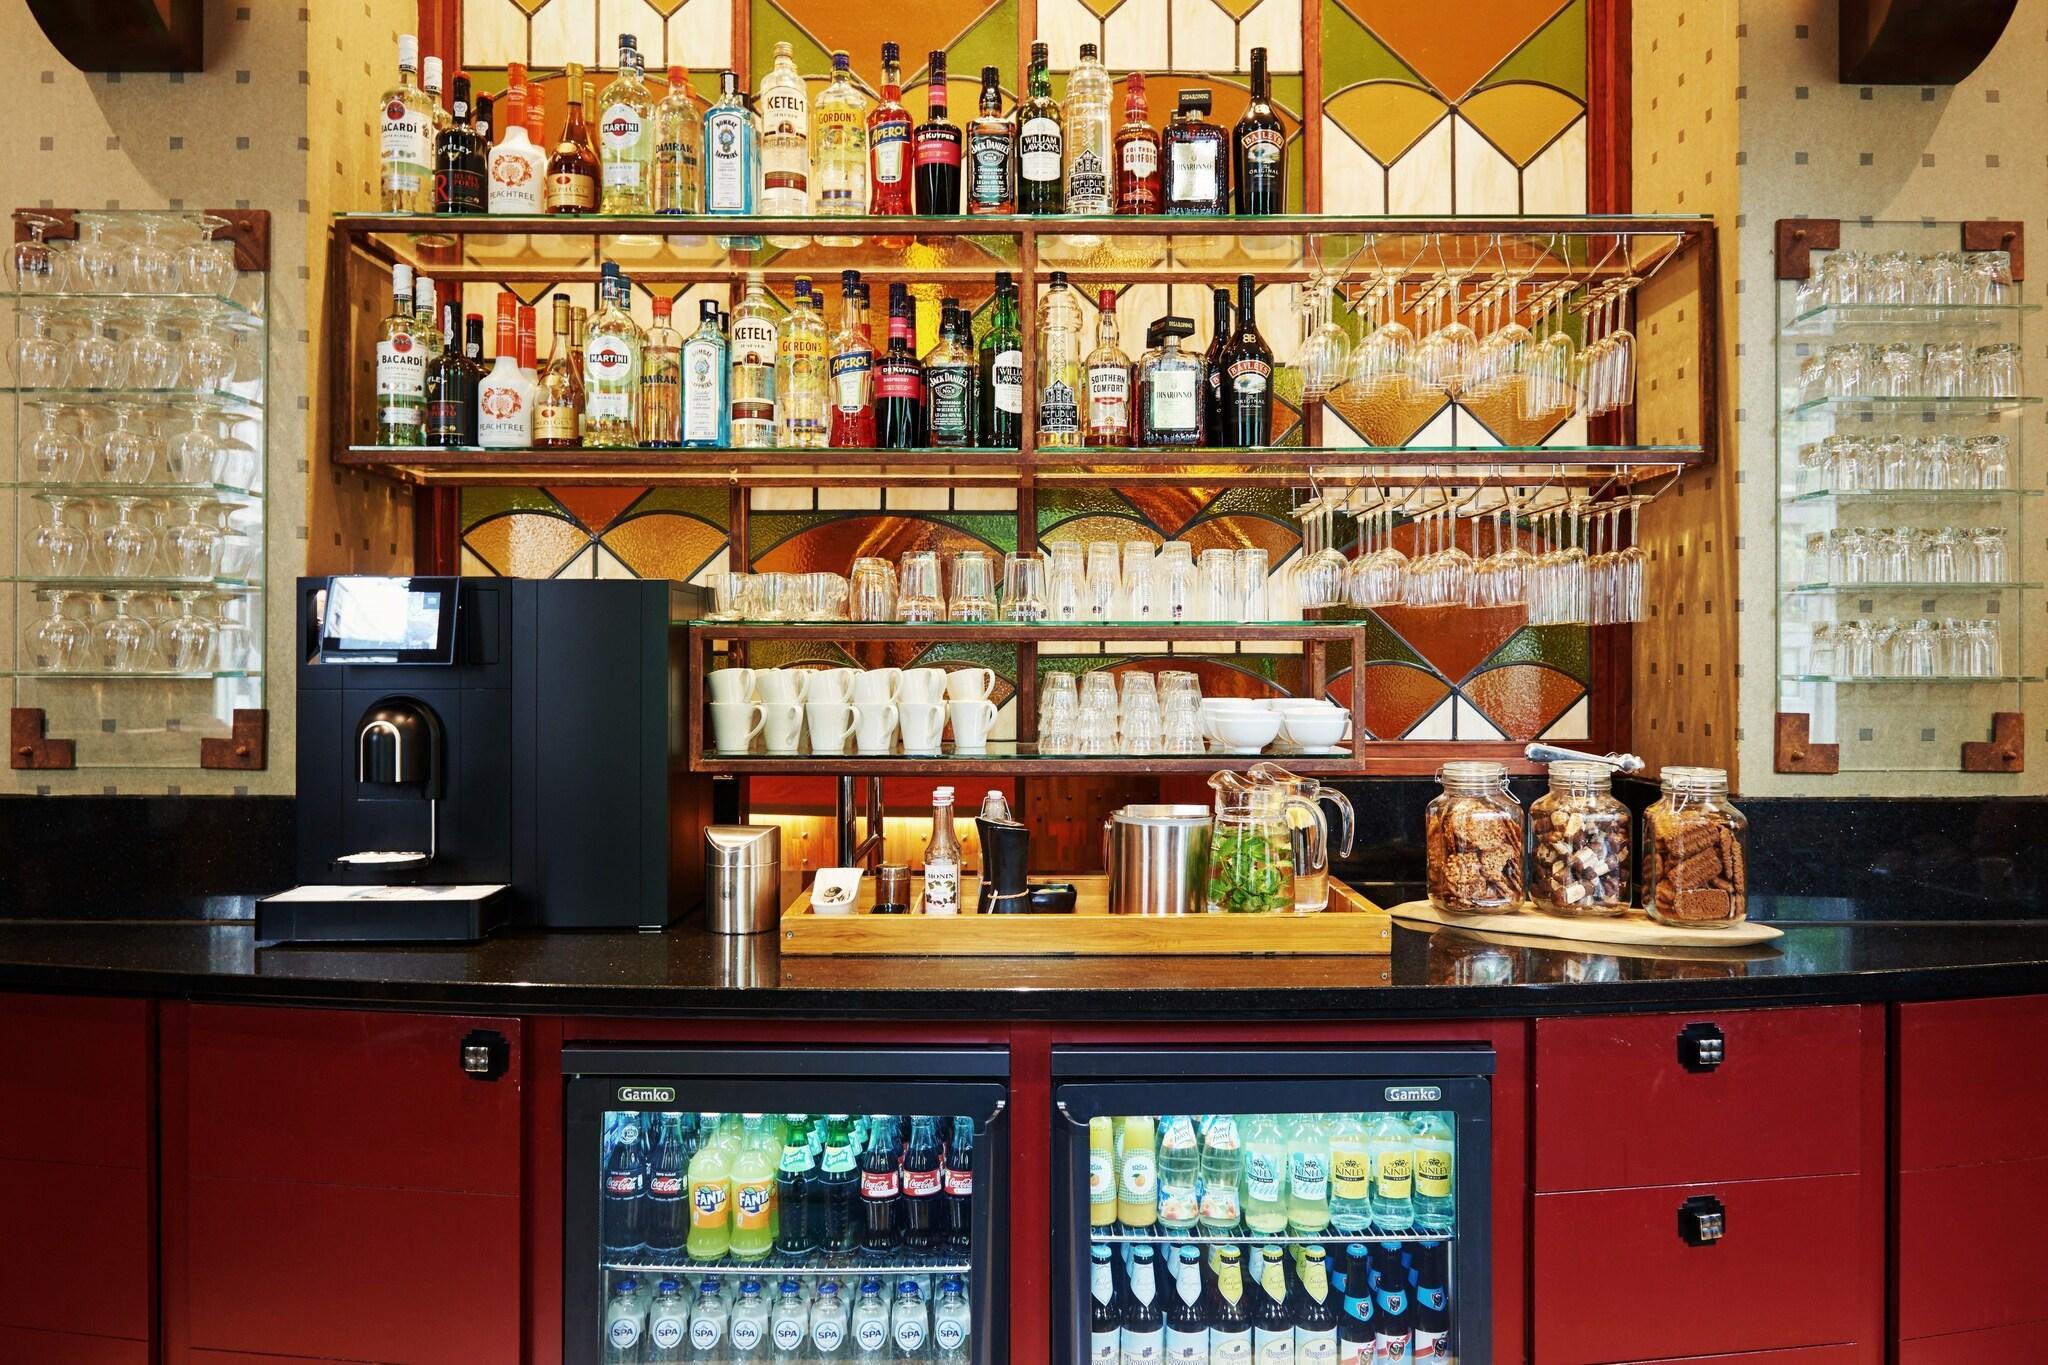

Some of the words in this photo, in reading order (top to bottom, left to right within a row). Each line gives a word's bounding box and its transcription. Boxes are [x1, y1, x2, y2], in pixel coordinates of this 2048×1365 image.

[768, 96, 798, 109] KETEL
[800, 101, 804, 112] 1
[602, 123, 638, 134] MARTINI
[716, 119, 738, 130] BOMBAY
[871, 126, 906, 143] APEROL
[1024, 136, 1058, 144] WILLIAM
[1246, 131, 1282, 147] BAILEYS
[438, 144, 472, 156] OFFLEY
[971, 141, 986, 154] JACK
[1023, 144, 1060, 153] LAWSON'S
[715, 150, 738, 160] SAPPHIRE
[734, 328, 766, 340] KETEL
[767, 330, 772, 342] 1
[382, 354, 423, 366] BACARDÍ
[590, 354, 628, 364] MARTINI
[832, 356, 868, 372] APEROL
[999, 366, 1022, 376] WILLIA
[1230, 361, 1269, 376] BAILEYS
[929, 374, 945, 388] JACK
[944, 373, 969, 388] DANIEL'S
[997, 375, 1022, 384] LAWSO
[1091, 374, 1126, 384] SOUTHERN
[1093, 384, 1124, 392] COMFORT
[1156, 391, 1192, 399] DISARONNO
[622, 1088, 670, 1101] Gamko
[1390, 1088, 1436, 1101] Gamko
[1336, 1164, 1365, 1176] KINLEY
[1384, 1165, 1411, 1176] KINLE
[1418, 1164, 1448, 1175] KINLEY
[607, 1175, 636, 1191] Coca-Cola
[650, 1176, 683, 1192] Coca-Cola
[864, 1180, 890, 1191] Coca-Cola
[908, 1179, 934, 1190] Coca-Cola
[950, 1179, 972, 1190] Coca-Col
[695, 1190, 726, 1205] FANTA
[739, 1190, 769, 1206] FANTA
[613, 1328, 633, 1337] SPA
[658, 1328, 678, 1337] SPA
[694, 1329, 714, 1338] SPA
[736, 1329, 755, 1338] SPA
[778, 1330, 798, 1338] SPA
[818, 1330, 838, 1339] SPA
[862, 1330, 882, 1338] SPA
[900, 1330, 920, 1338] SPA
[940, 1329, 960, 1338] SPA
